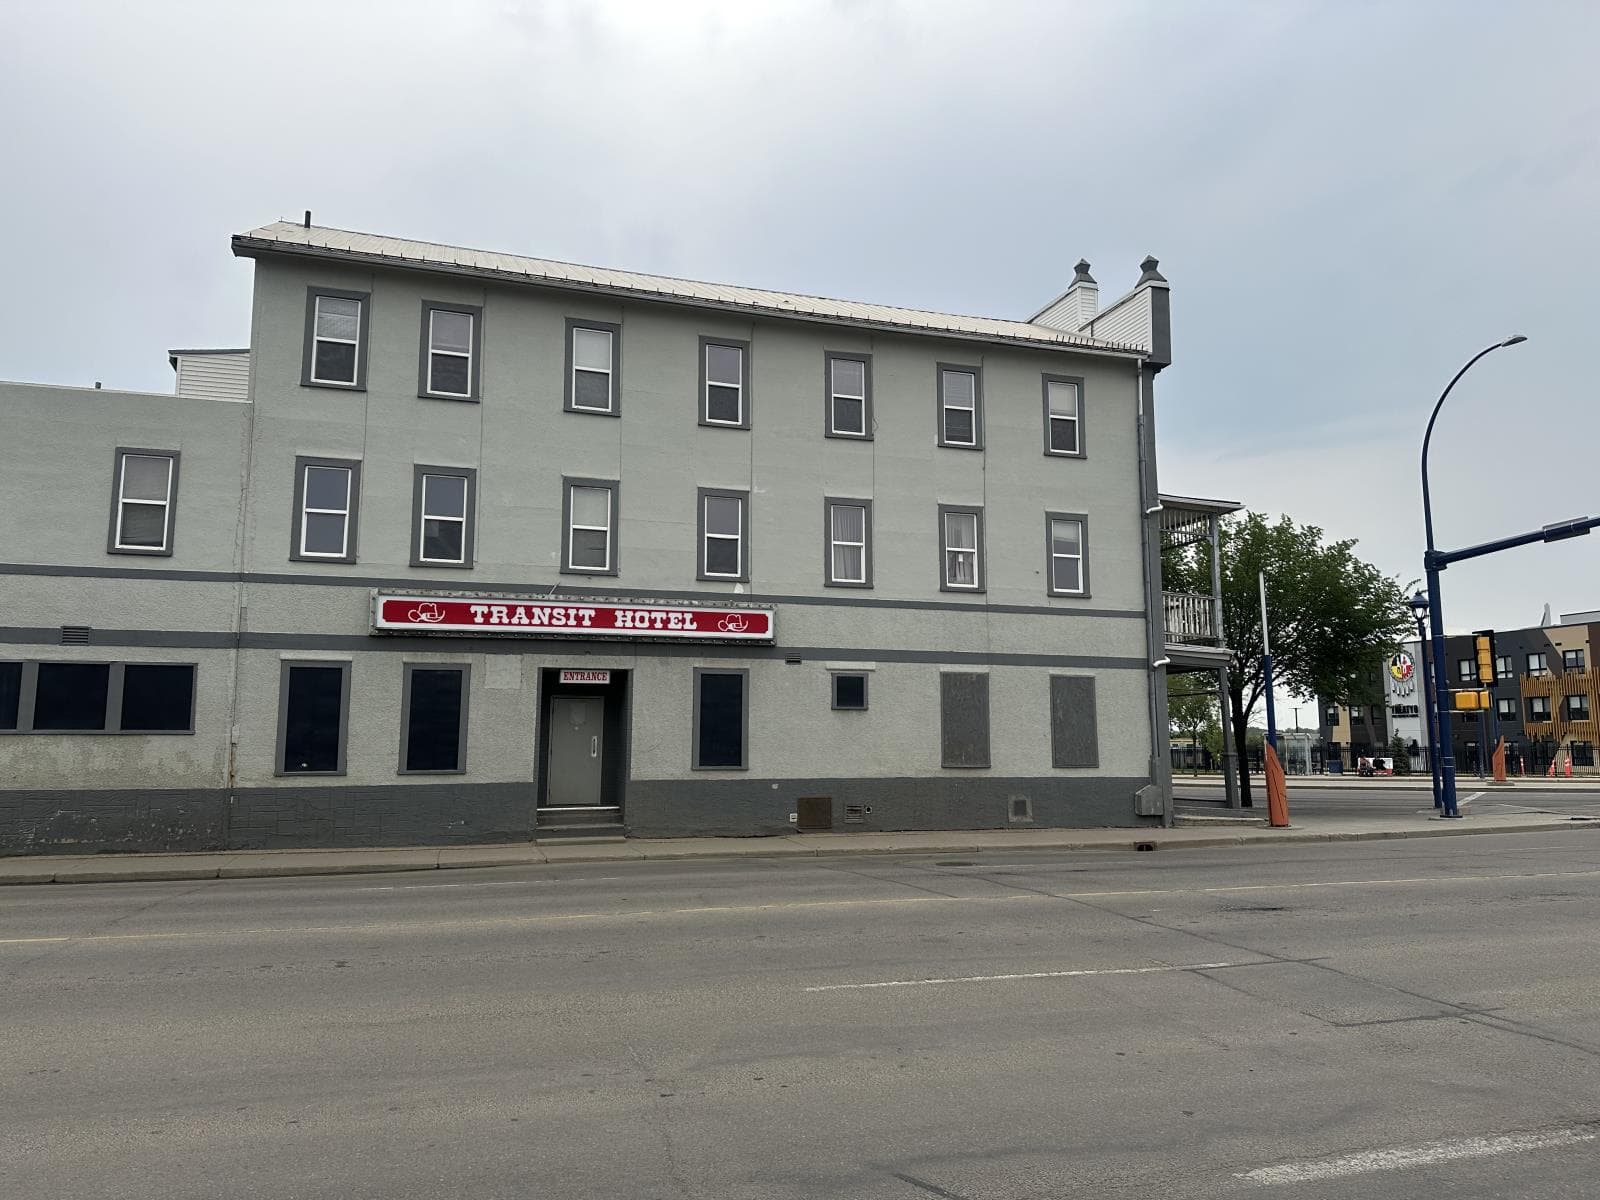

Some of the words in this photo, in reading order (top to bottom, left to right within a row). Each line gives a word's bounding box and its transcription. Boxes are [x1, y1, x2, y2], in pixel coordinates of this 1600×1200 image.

[470, 605, 595, 626] TRANSIT
[615, 610, 697, 629] HOTEL
[563, 671, 608, 681] ENTRANCE
